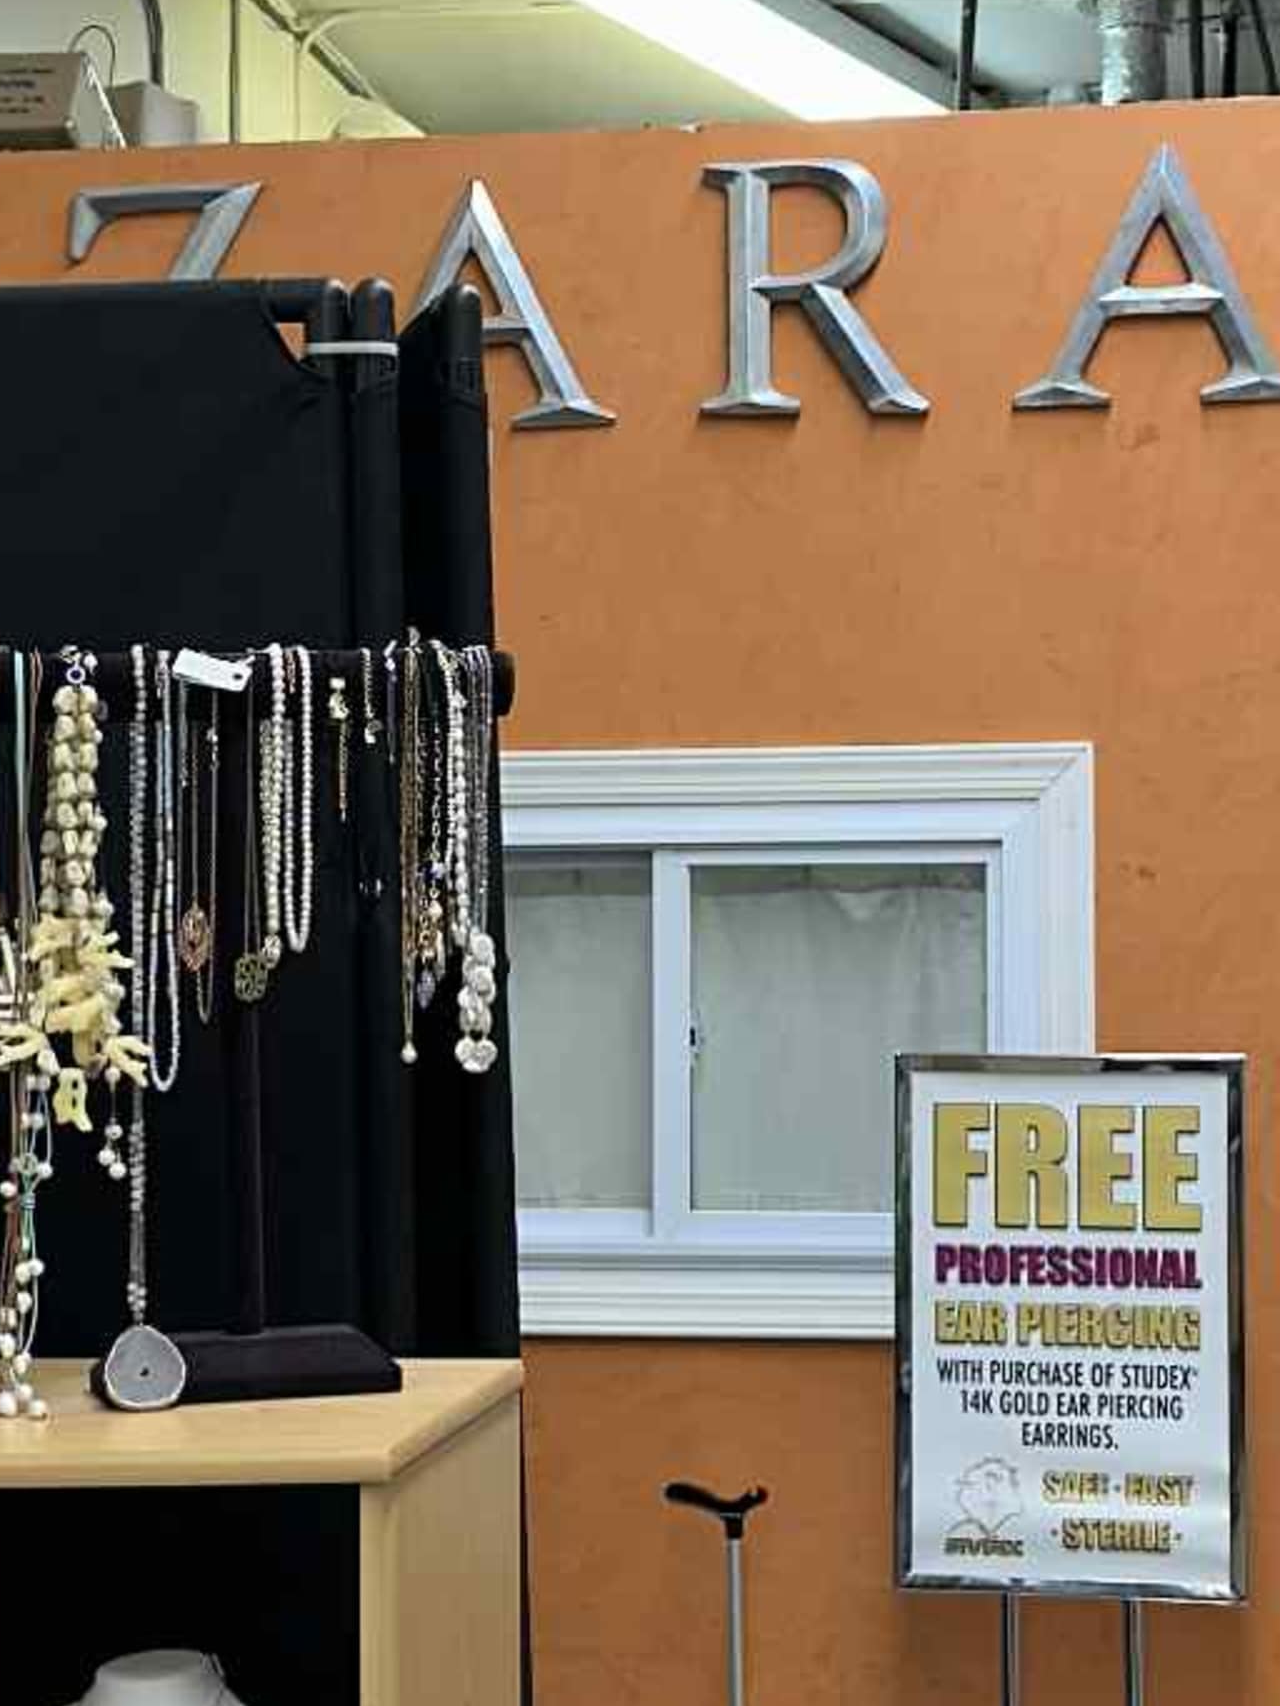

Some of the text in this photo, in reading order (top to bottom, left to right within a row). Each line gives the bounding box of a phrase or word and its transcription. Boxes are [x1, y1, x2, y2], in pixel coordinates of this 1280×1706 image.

[934, 1102, 1202, 1231] FREE
[935, 1244, 1202, 1289] PROFESSIONAL
[935, 1300, 1201, 1351] EAR PIERCING
[937, 1357, 984, 1384] WITH
[989, 1360, 1084, 1388] PURCHASE
[1091, 1363, 1115, 1388] OF
[960, 1389, 1185, 1421] 14K GOLD EAR PIERCING
[1021, 1422, 1119, 1450] EARRINGS.
[1124, 1472, 1196, 1506] FAST
[1061, 1517, 1172, 1554] STERILE
